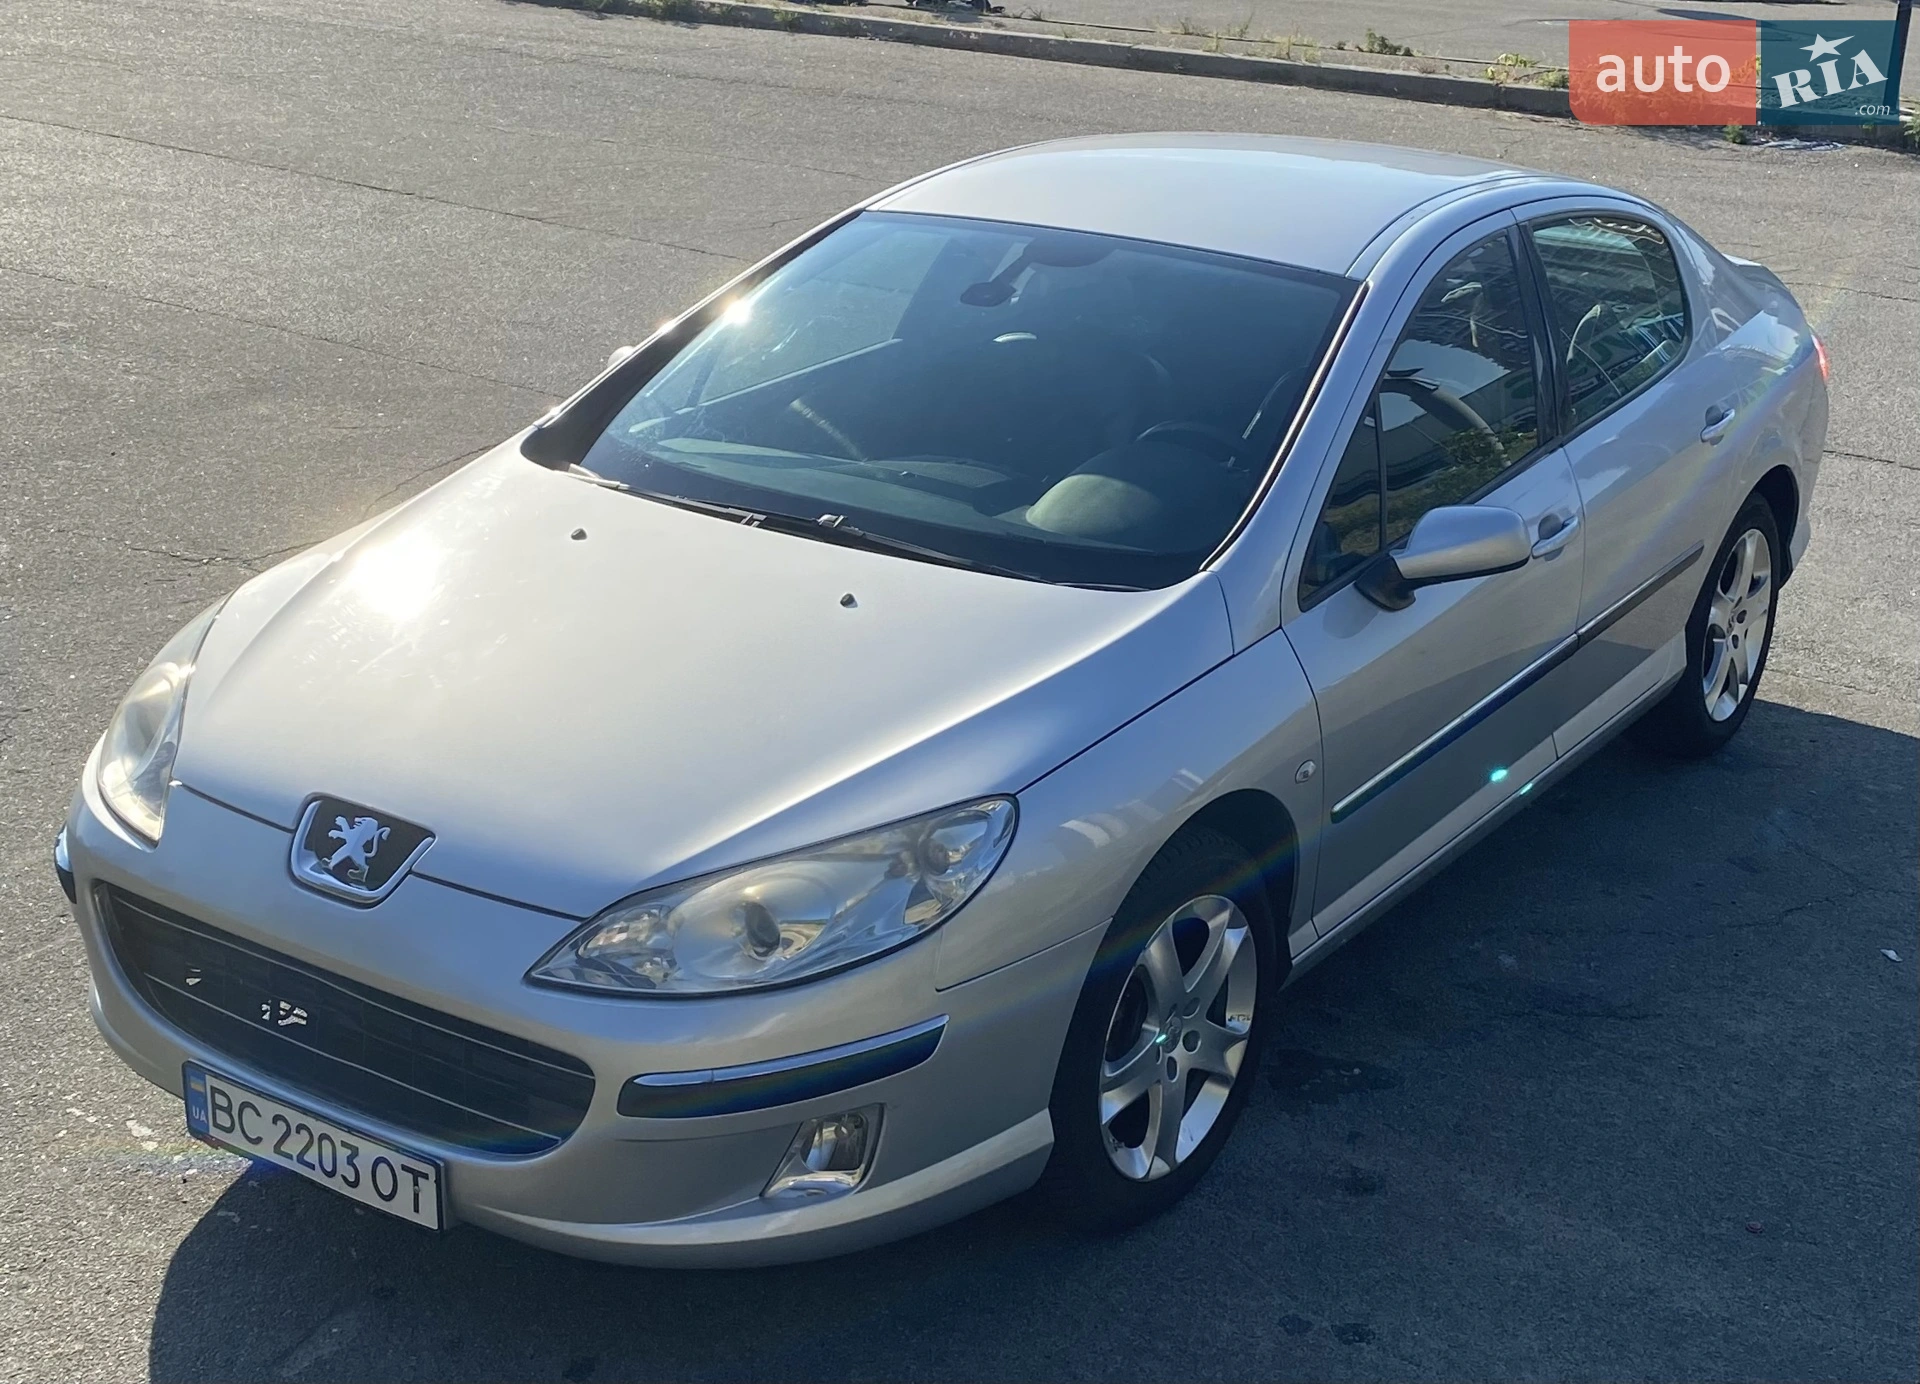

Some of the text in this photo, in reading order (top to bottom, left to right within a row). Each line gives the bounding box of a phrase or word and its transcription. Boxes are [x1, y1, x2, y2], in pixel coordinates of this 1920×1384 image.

[192, 1105, 208, 1124] UA
[210, 1085, 430, 1214] BC 2203 OT
